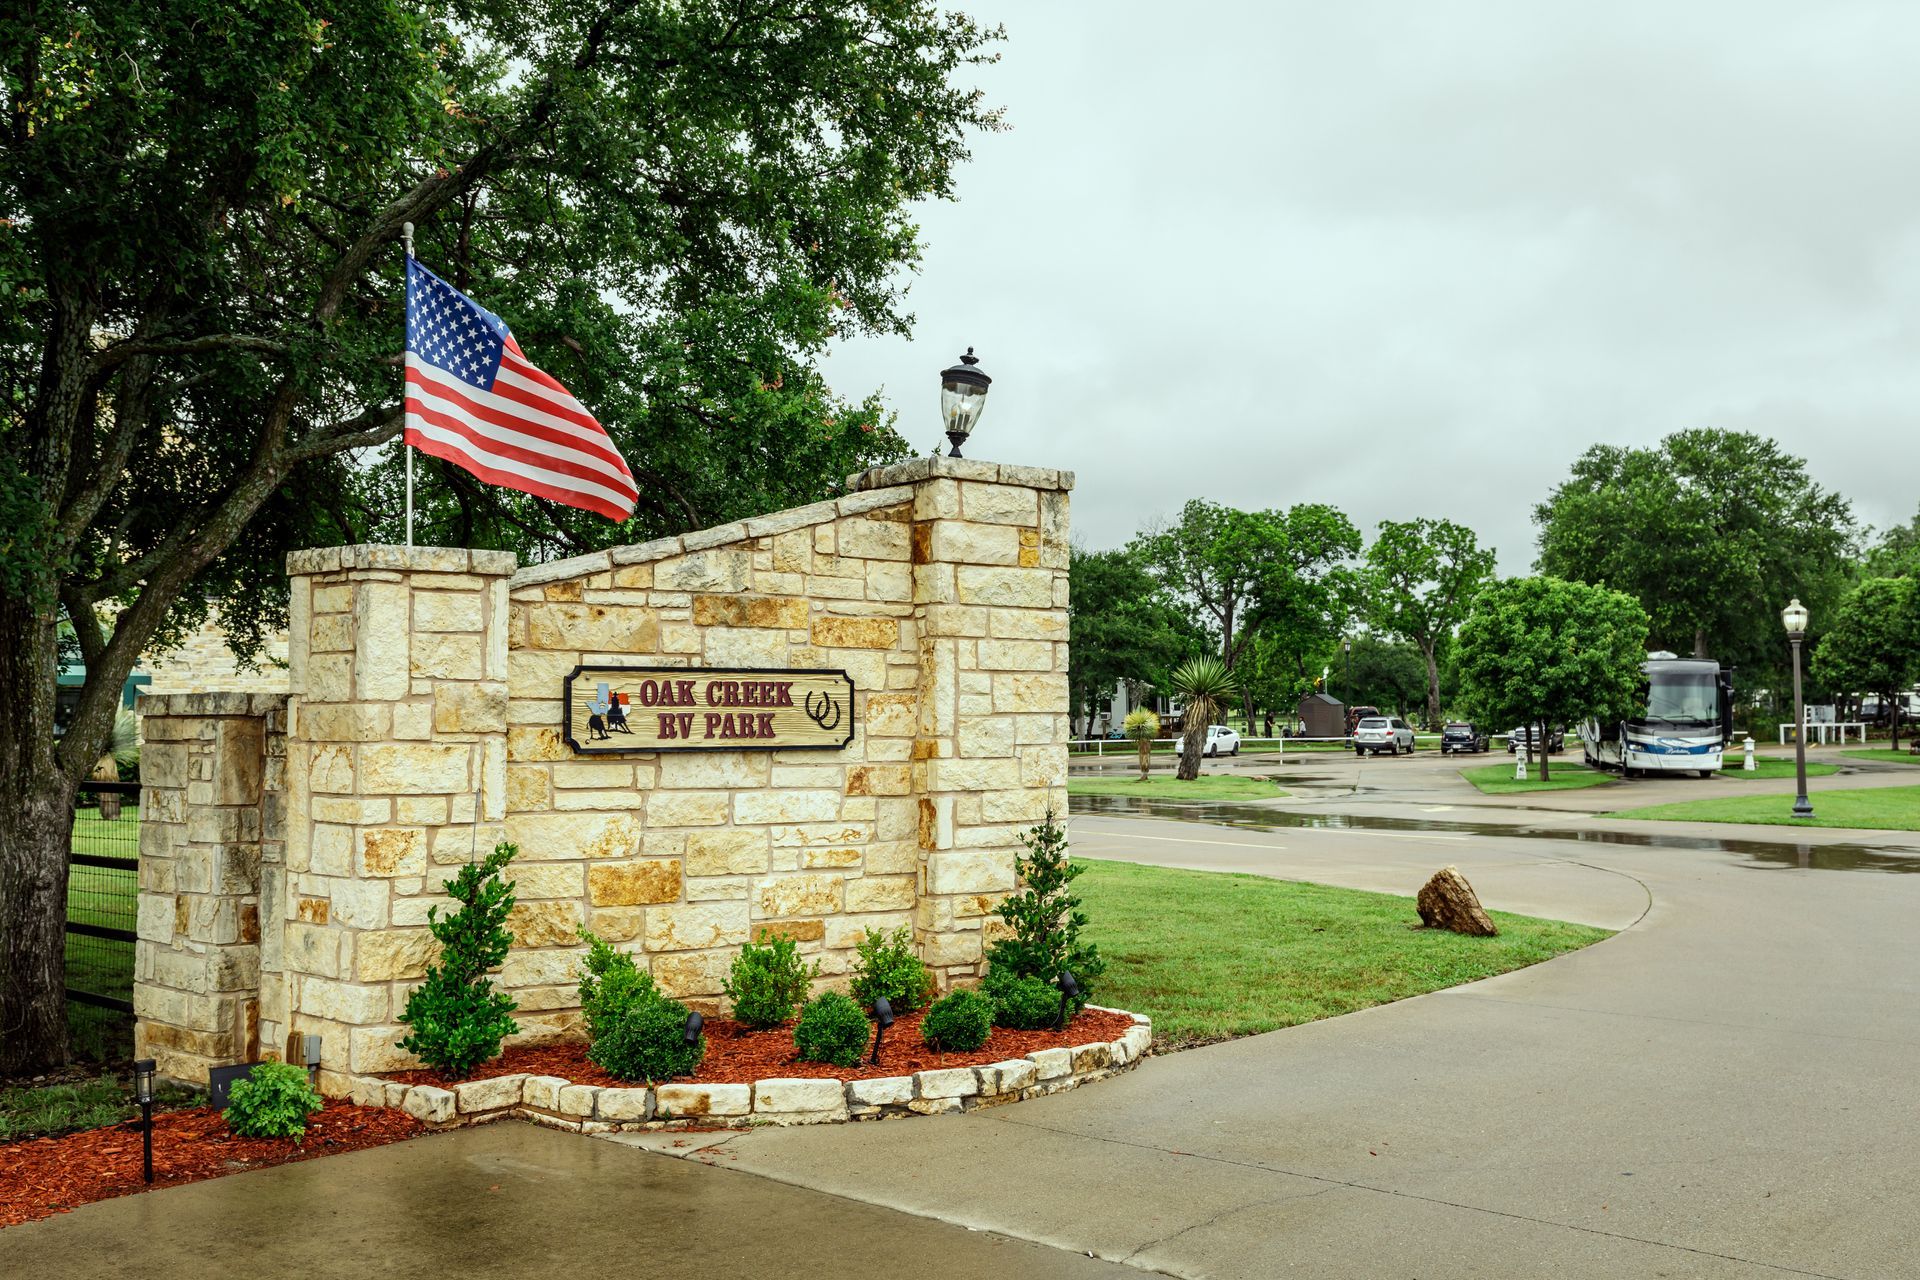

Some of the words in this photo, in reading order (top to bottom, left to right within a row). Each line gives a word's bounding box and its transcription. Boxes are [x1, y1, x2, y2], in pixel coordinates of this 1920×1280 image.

[640, 679, 696, 707] OAK
[706, 680, 794, 707] CREEK
[657, 712, 696, 739] RV
[704, 712, 776, 739] PARK
